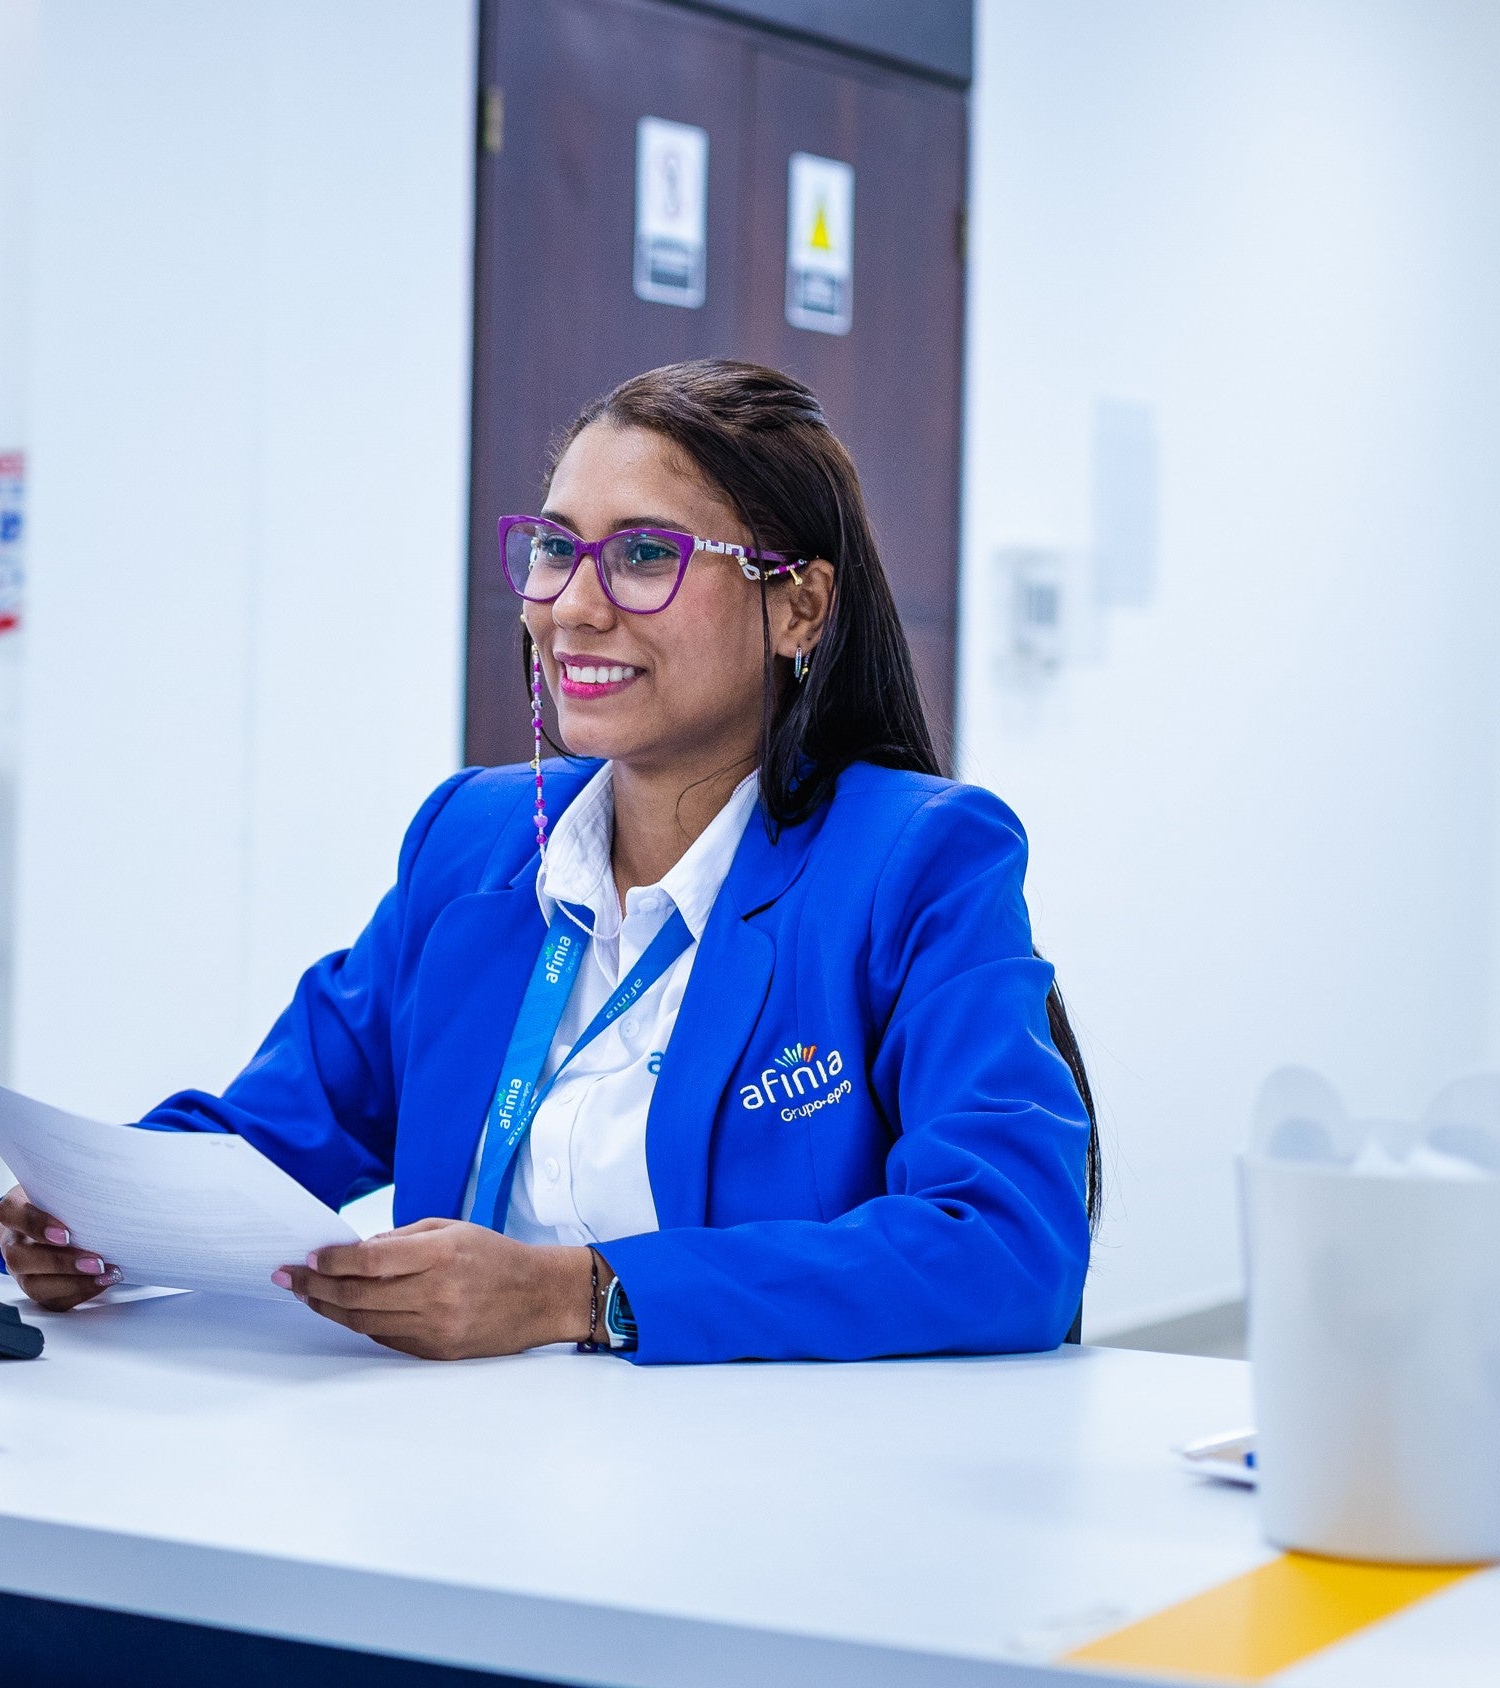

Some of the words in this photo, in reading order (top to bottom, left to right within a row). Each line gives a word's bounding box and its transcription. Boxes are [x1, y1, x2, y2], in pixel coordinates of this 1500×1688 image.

[546, 935, 571, 984] afinia
[605, 978, 643, 1020] afinia
[499, 1078, 522, 1129] afinia
[739, 1049, 844, 1110] afinia
